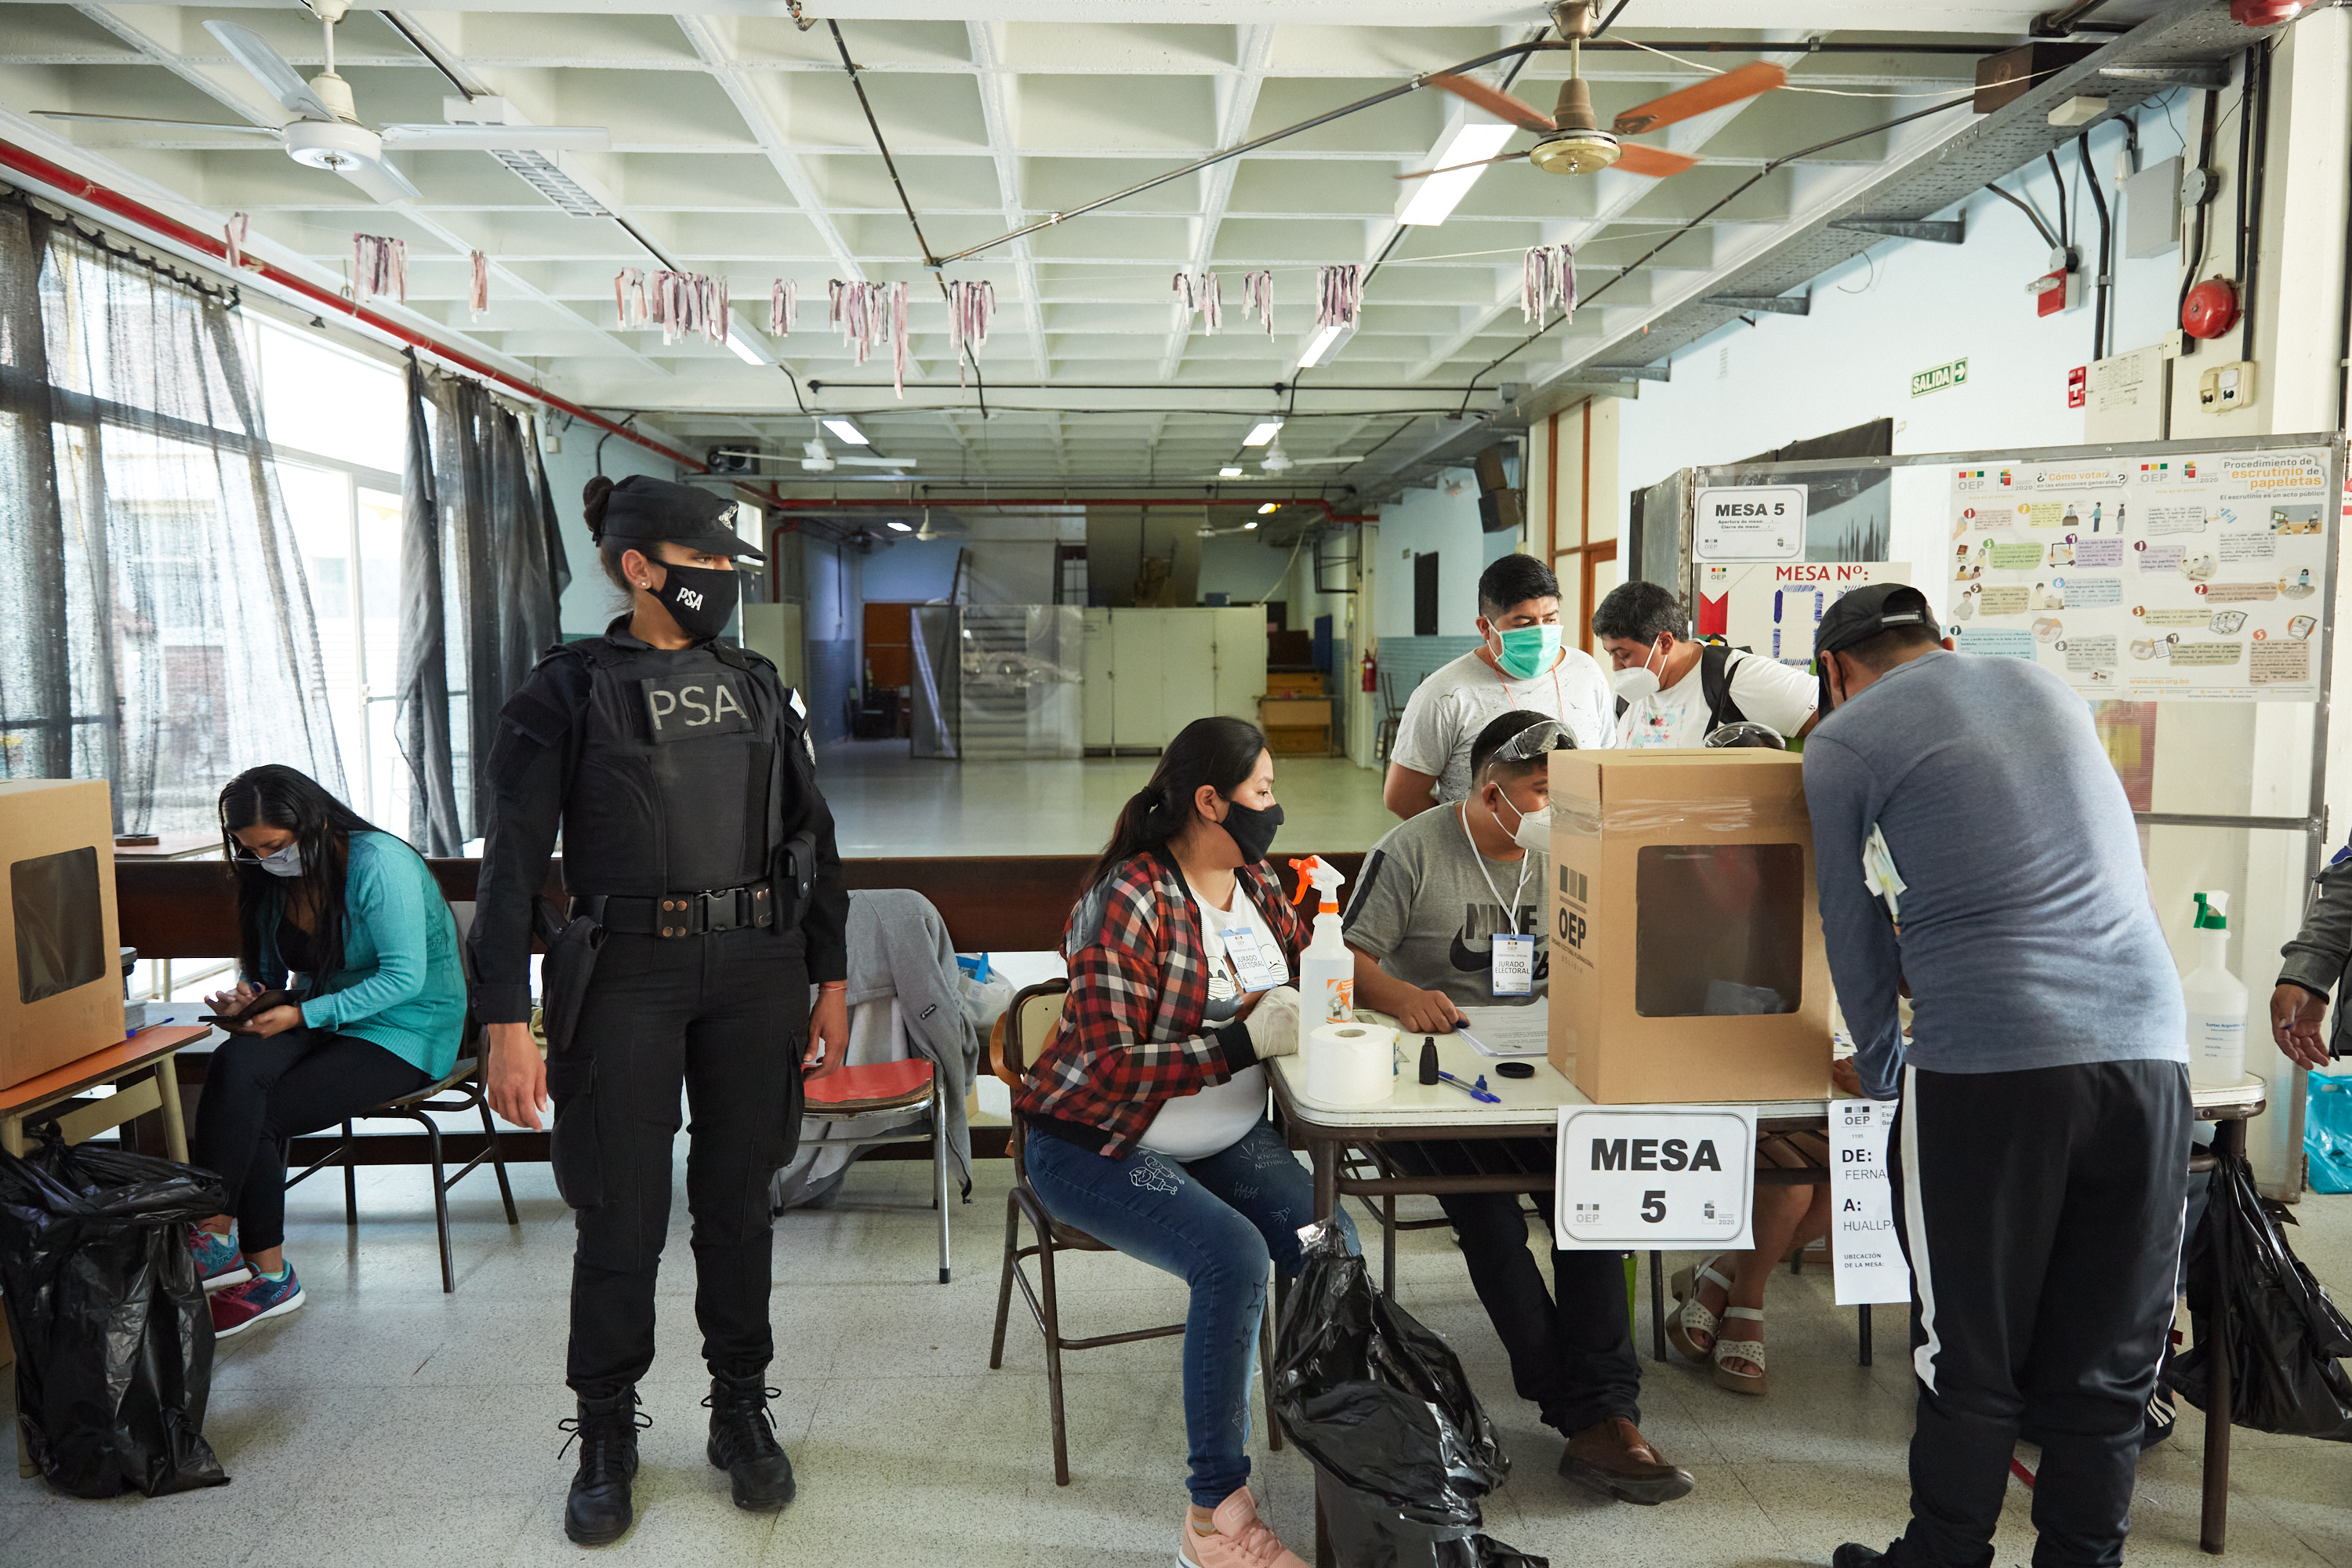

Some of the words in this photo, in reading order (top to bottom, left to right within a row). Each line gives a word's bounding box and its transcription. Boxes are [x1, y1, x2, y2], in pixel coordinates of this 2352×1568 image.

[1912, 367, 1951, 394] SALIDA
[2224, 458, 2297, 469] Procedimiento
[2049, 472, 2077, 481] Cómo
[2078, 471, 2107, 480] votar
[2140, 473, 2168, 483] OEP
[2231, 466, 2303, 479] escrutinio
[1958, 481, 1984, 491] OEP
[2250, 476, 2321, 490] papeletas
[1715, 503, 1768, 517] MESA
[1773, 503, 1785, 516] 5
[1776, 565, 1830, 581] MESA
[676, 586, 704, 612] PSA
[648, 684, 748, 731] PSA
[1559, 907, 1586, 949] OEP
[1236, 960, 1265, 970] ELECTORAL
[1845, 1116, 1871, 1125] OEP
[1591, 1138, 1722, 1172] MESA
[1842, 1149, 1871, 1163] DE:
[1640, 1190, 1667, 1224] 5
[1843, 1198, 1861, 1212] A:
[1576, 1214, 1599, 1223] OEP
[218, 1251, 234, 1265] FILA
